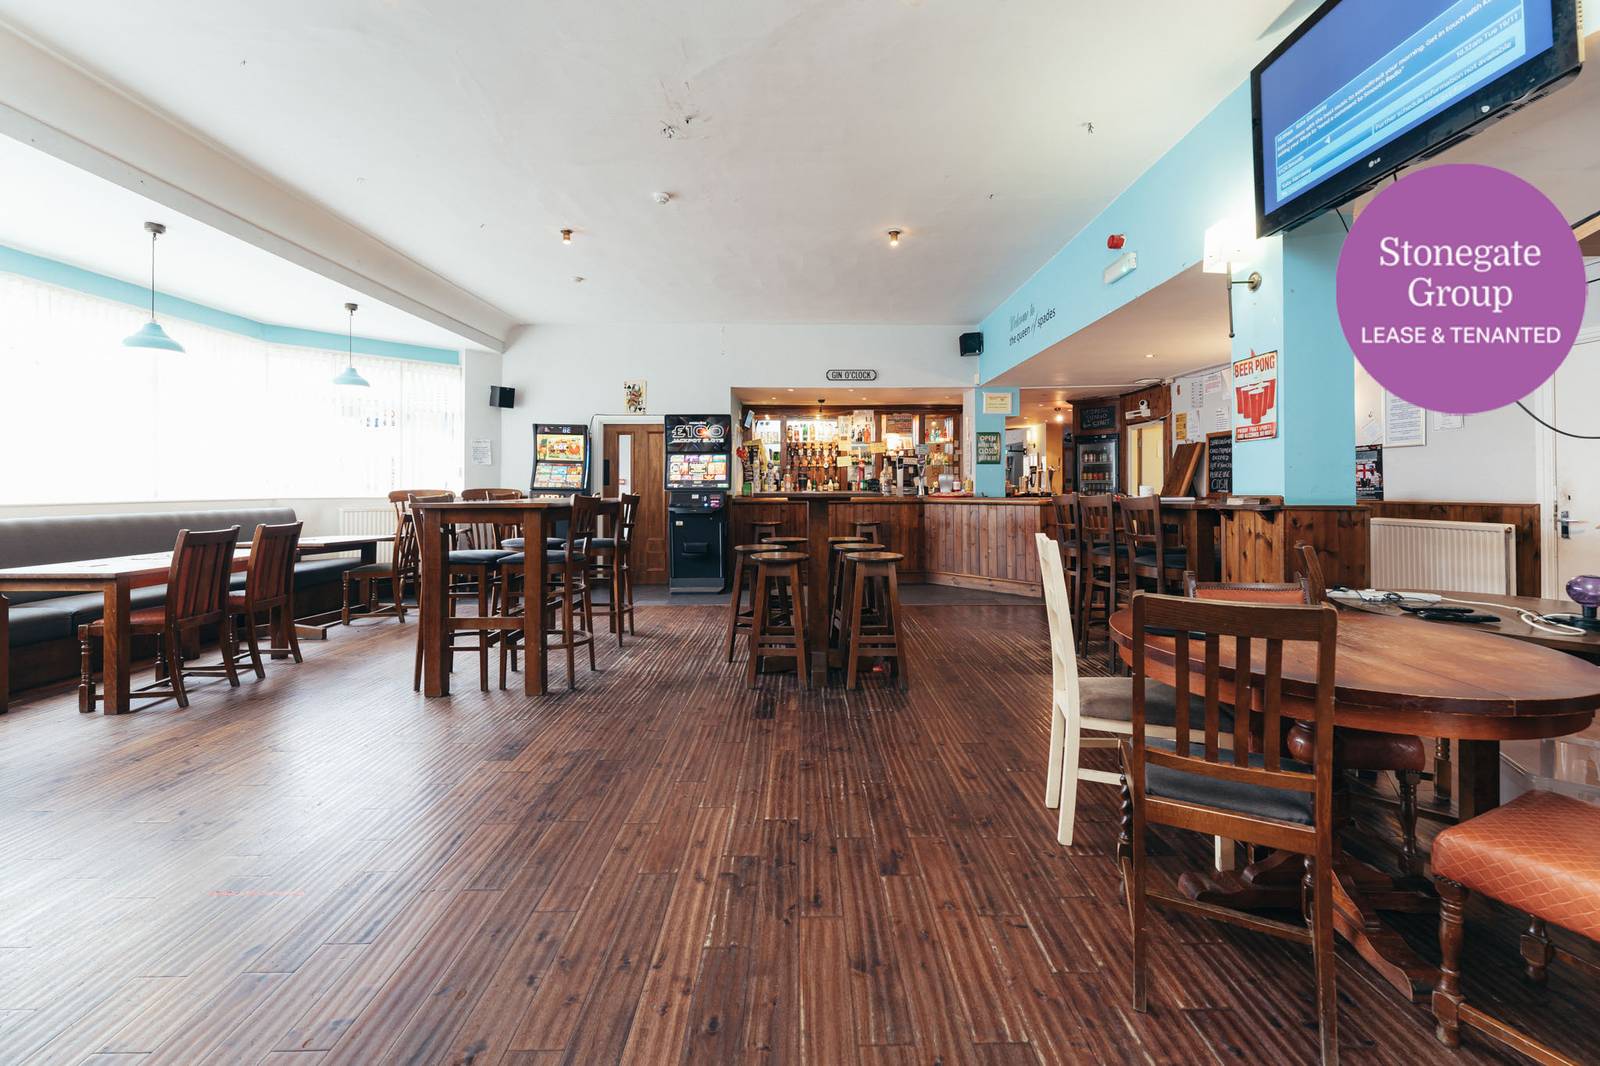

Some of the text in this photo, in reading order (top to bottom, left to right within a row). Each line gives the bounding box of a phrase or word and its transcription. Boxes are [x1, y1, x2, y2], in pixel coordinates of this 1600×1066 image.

[1017, 326, 1031, 344] queen
[1037, 308, 1056, 329] spades
[831, 371, 872, 379] GIN O'CLOCK
[1234, 354, 1276, 378] BEER PONG
[671, 424, 725, 438] £100
